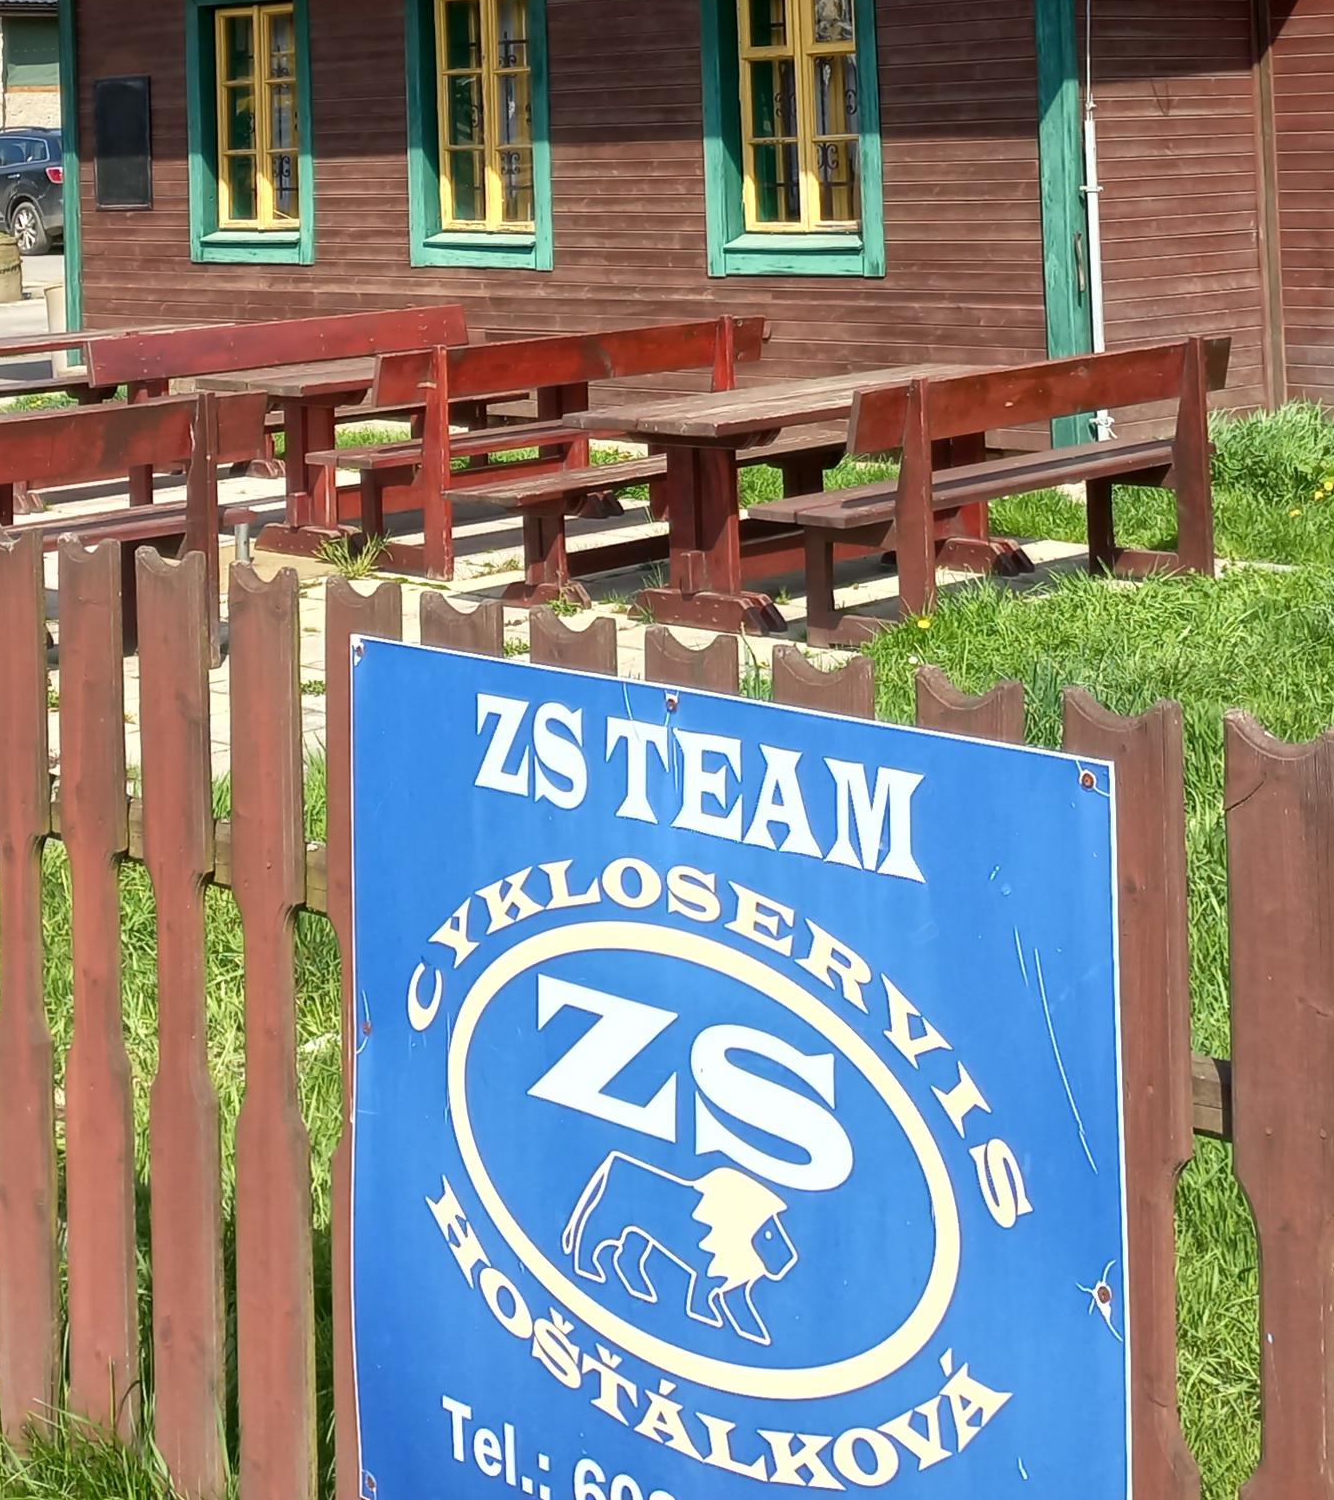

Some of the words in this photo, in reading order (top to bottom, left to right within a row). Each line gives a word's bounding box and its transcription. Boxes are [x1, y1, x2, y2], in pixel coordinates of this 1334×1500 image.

[474, 691, 588, 810] ZS
[605, 716, 926, 883] TEAM
[407, 856, 1033, 1229] CYKLOSERVIS
[526, 973, 854, 1192] ZS
[425, 1174, 1013, 1491] HOŠŤÁLKOVÁ
[443, 1395, 551, 1500] Tel.:
